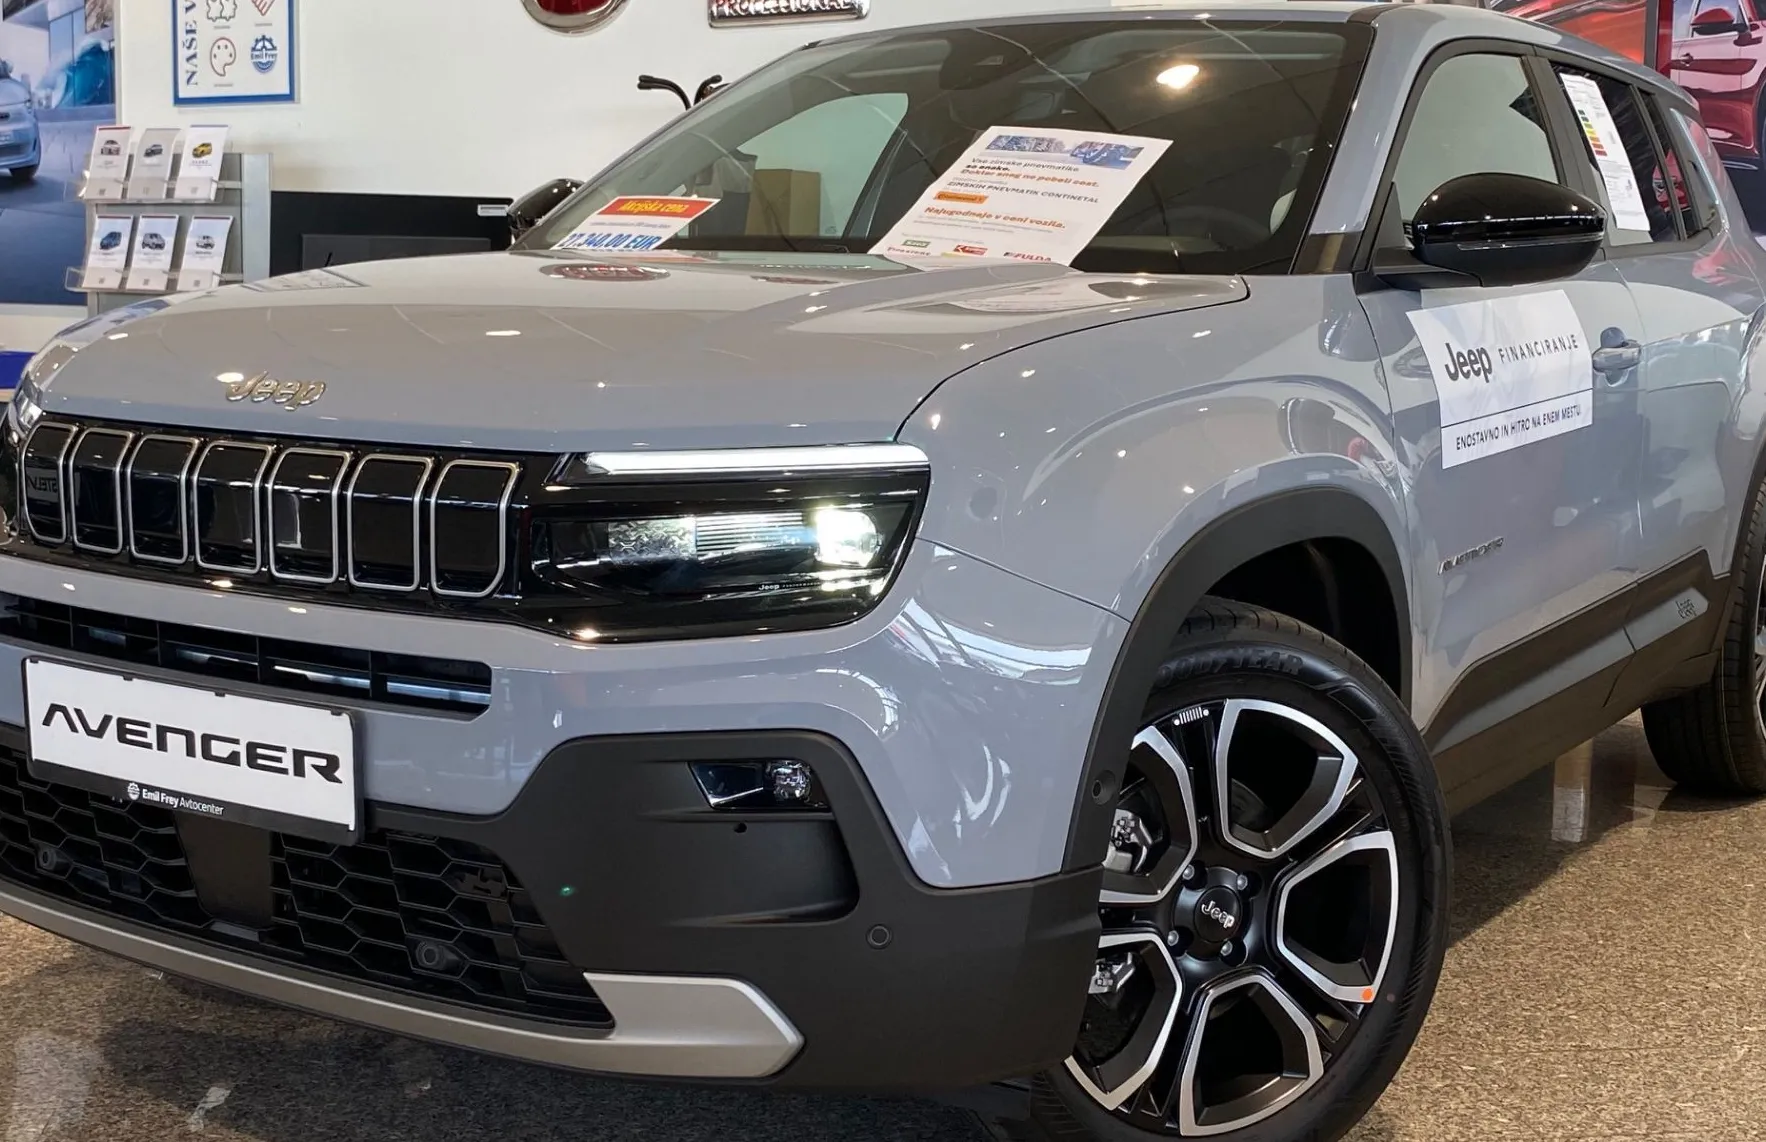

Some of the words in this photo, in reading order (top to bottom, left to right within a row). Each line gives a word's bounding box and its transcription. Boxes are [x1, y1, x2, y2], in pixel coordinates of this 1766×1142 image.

[183, 20, 198, 86] NAŠE
[986, 184, 1039, 196] PNEVMATIK
[623, 234, 662, 250] EUR
[1444, 342, 1493, 383] Jeep
[1498, 334, 1579, 364] FINANCIRANJE
[225, 370, 326, 411] Jeep
[1456, 426, 1500, 450] ENOSTAVNO
[1501, 424, 1509, 437] IN
[1510, 417, 1531, 434] HITRO
[1532, 414, 1541, 428] NA
[1542, 409, 1560, 426] ENEM
[42, 702, 343, 784] AVENGER
[142, 788, 160, 802] Emil
[161, 793, 180, 808] Frey
[180, 797, 225, 815] Avtocenter
[1201, 900, 1235, 929] Jeep
